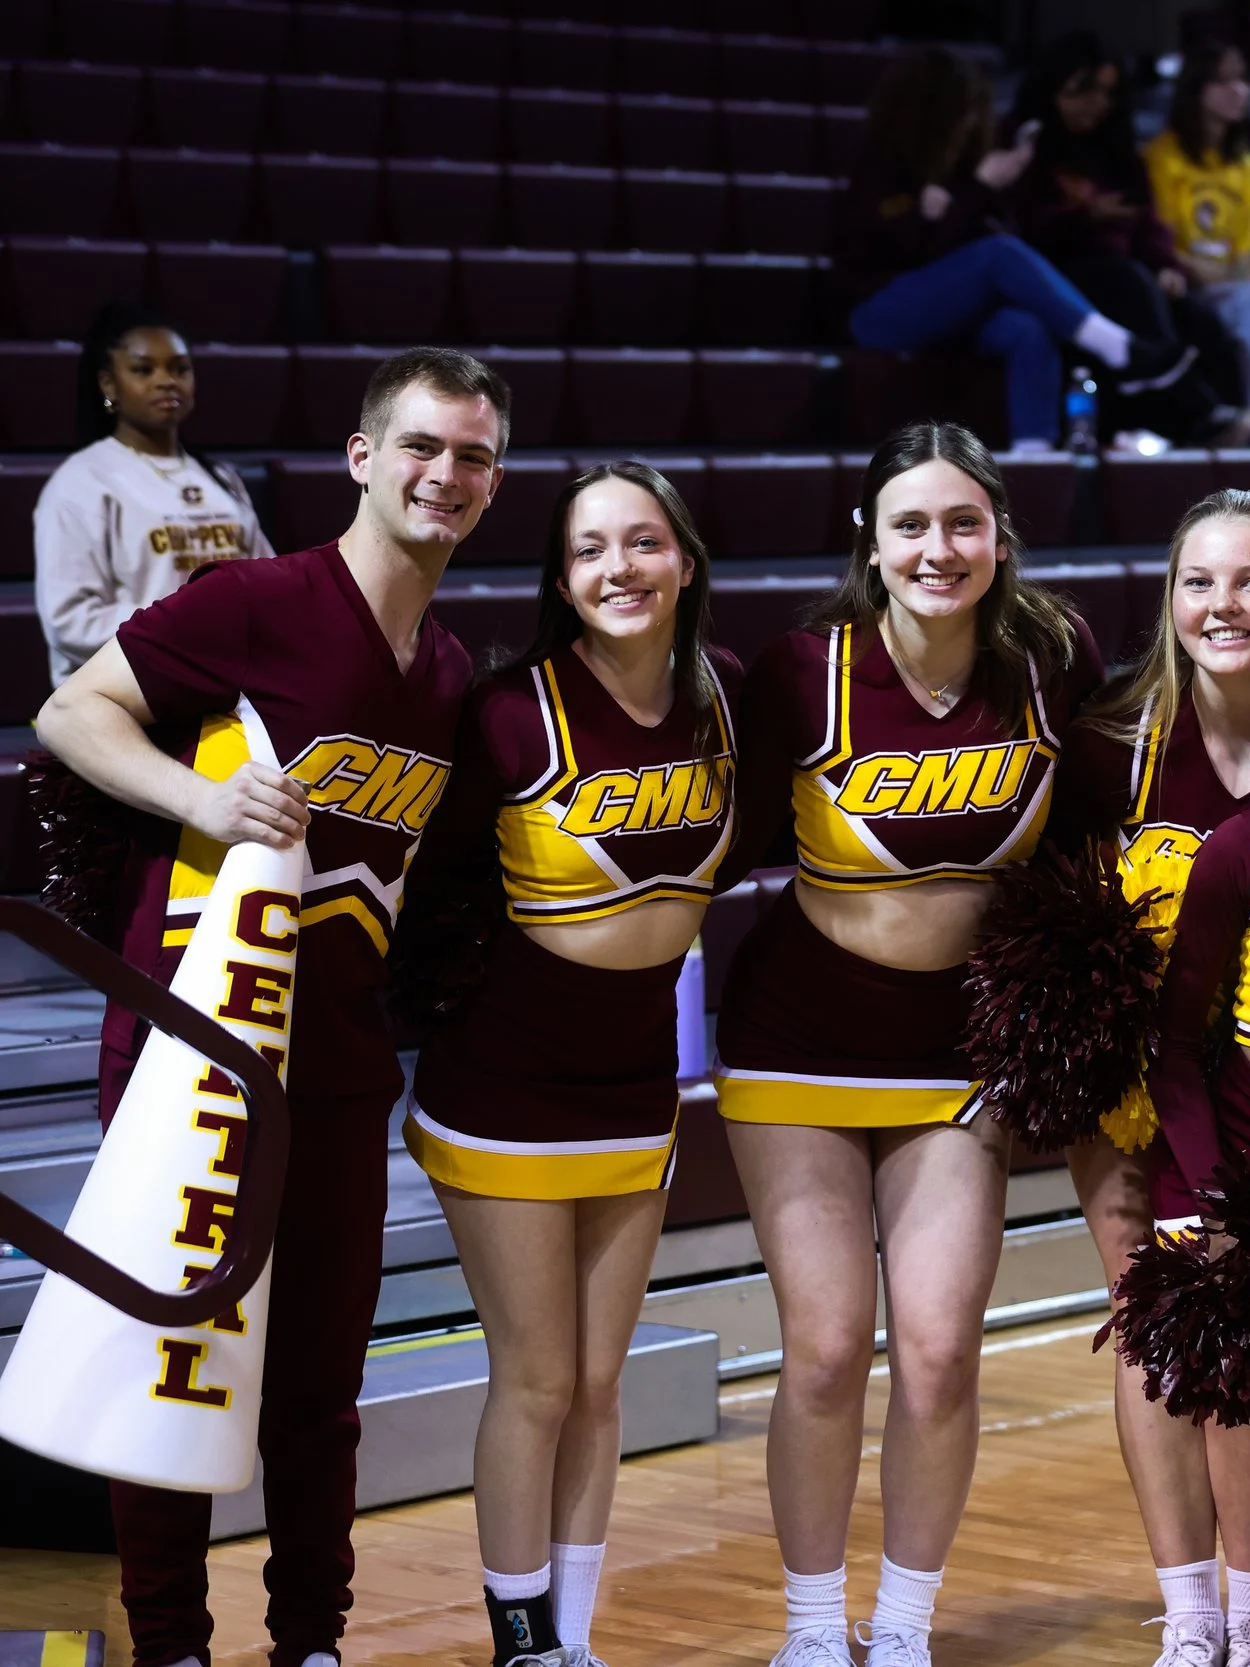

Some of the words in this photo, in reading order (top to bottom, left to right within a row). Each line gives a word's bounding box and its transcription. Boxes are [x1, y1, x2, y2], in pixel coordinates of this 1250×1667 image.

[281, 733, 452, 836] CMU
[556, 751, 731, 838] CMU
[833, 738, 1040, 818] CMU
